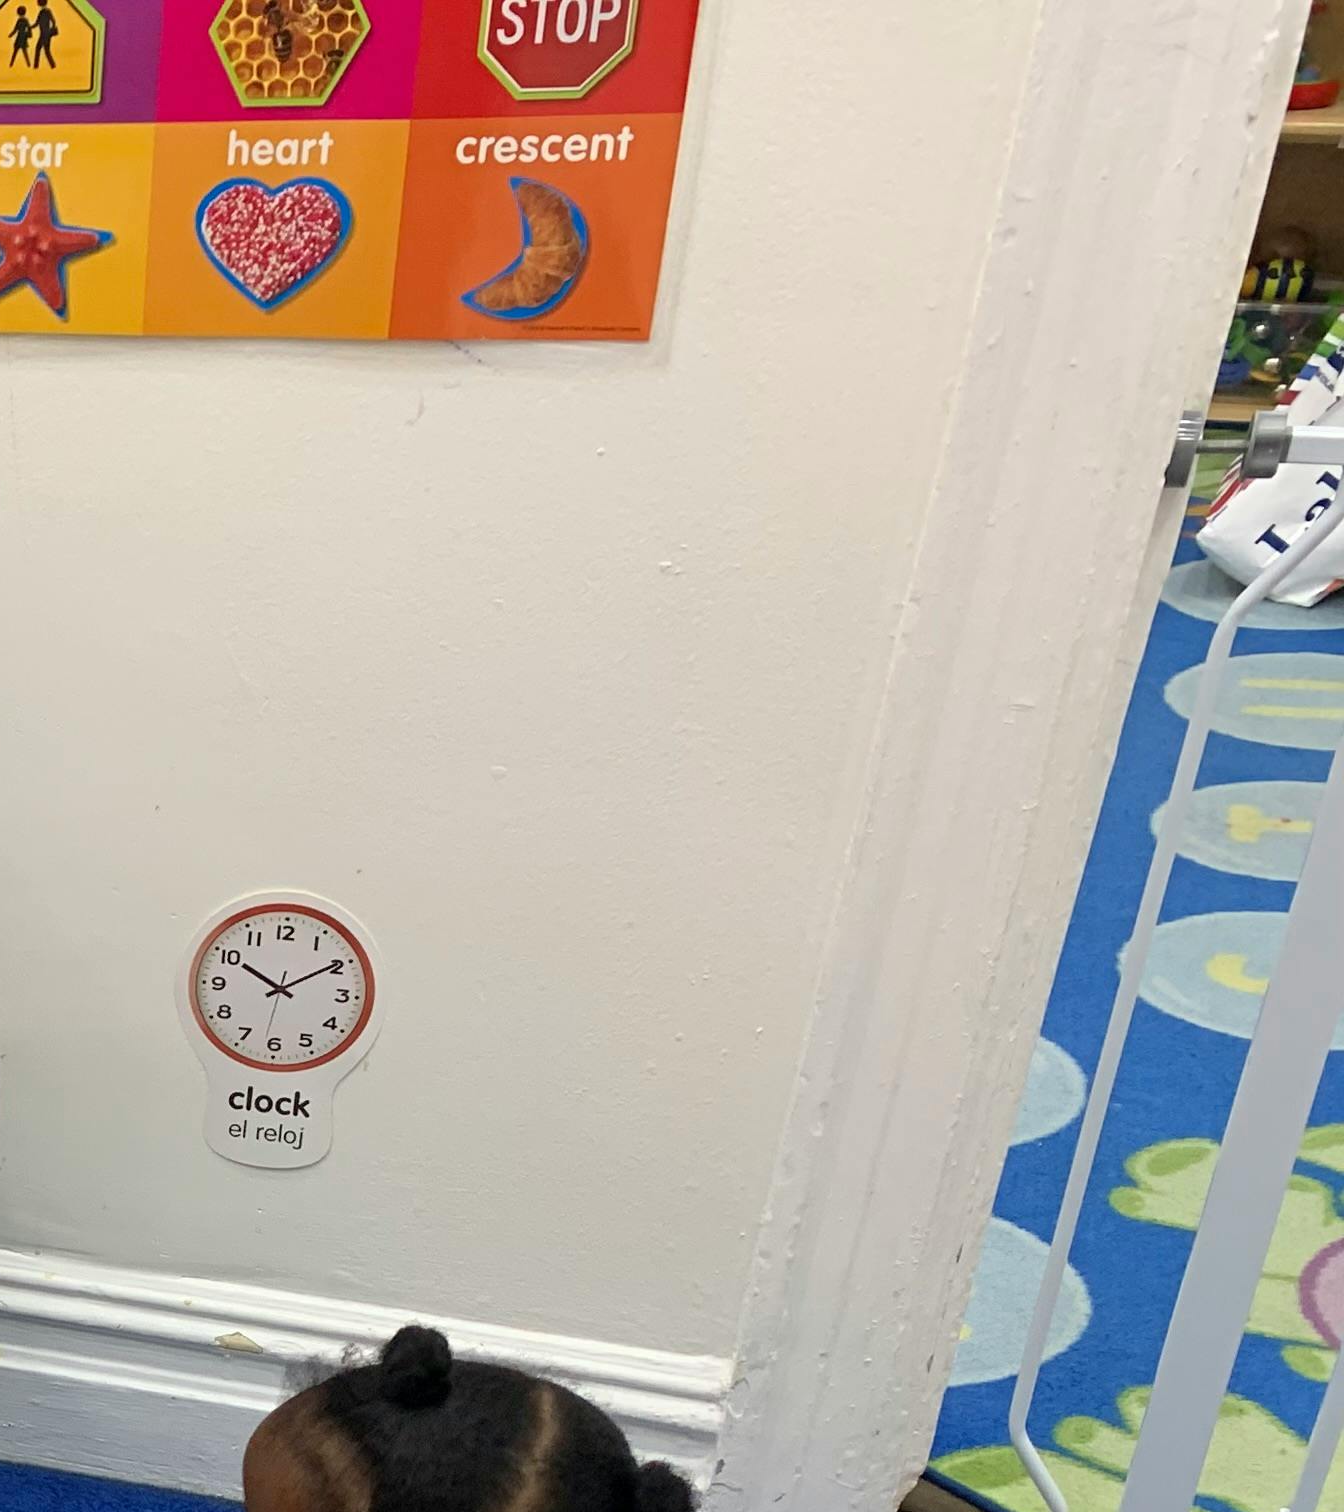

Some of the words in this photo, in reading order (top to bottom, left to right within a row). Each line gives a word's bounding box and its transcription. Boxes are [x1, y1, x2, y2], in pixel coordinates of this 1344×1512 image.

[496, 0, 622, 45] STOP
[227, 130, 334, 166] heart
[456, 126, 634, 164] crescent
[246, 930, 263, 948] 11
[275, 924, 295, 942] 12
[312, 936, 321, 952] 1
[220, 949, 241, 966] 10
[329, 960, 345, 975] 2
[211, 976, 227, 991] 9
[334, 989, 350, 1003] 3
[216, 1004, 232, 1020] 8
[322, 1016, 338, 1031] 4
[238, 1027, 252, 1041] 7
[298, 1033, 313, 1048] 5
[267, 1036, 282, 1052] 6
[228, 1087, 310, 1119] clock
[228, 1120, 247, 1139] el
[255, 1124, 305, 1150] reloj
